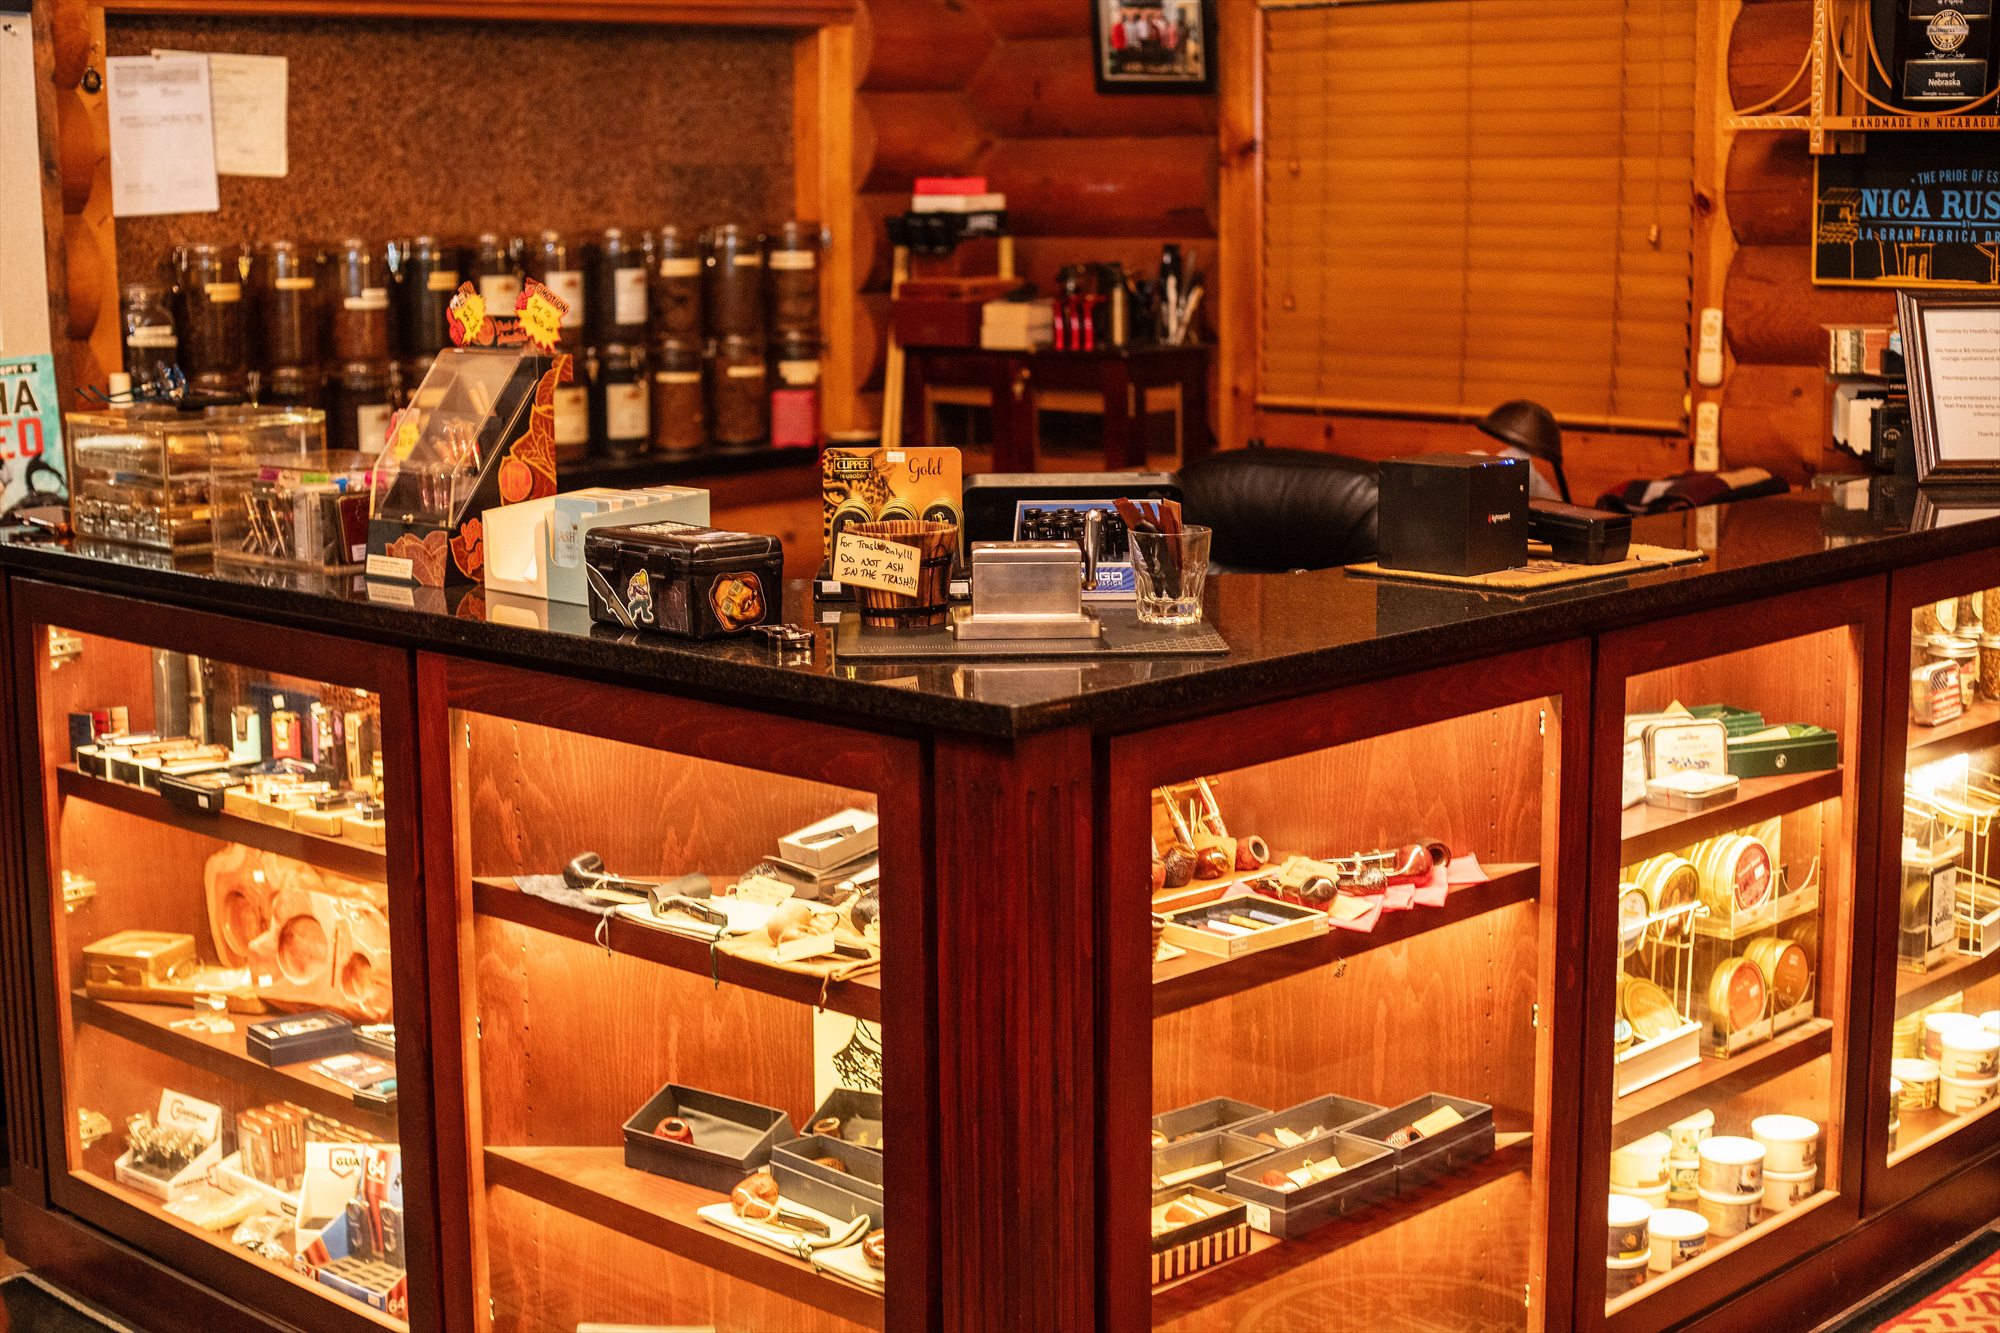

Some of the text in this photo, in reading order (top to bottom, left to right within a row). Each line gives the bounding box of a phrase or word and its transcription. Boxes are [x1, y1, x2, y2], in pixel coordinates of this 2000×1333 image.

[1927, 78, 1961, 87] Nebraska
[1934, 71, 1949, 79] State
[1851, 116, 1913, 129] HANDMADE
[1918, 117, 1931, 129] IN
[1917, 171, 1936, 185] THE
[1939, 169, 1969, 182] PRIDE
[1971, 169, 1984, 182] OF
[1860, 188, 1931, 218] NICA
[1859, 227, 1873, 241] LA
[1880, 228, 1914, 241] GRAN
[1921, 229, 1977, 243] FABRICA
[836, 459, 870, 471] CLIPPER
[908, 456, 943, 483] Gold
[839, 472, 868, 480] reusable
[857, 539, 880, 551] Trash
[840, 553, 905, 574] DO NOT ASH
[841, 567, 918, 592] IN THE TRASH!!!
[367, 1158, 387, 1180] 64
[388, 1295, 407, 1314] 64
